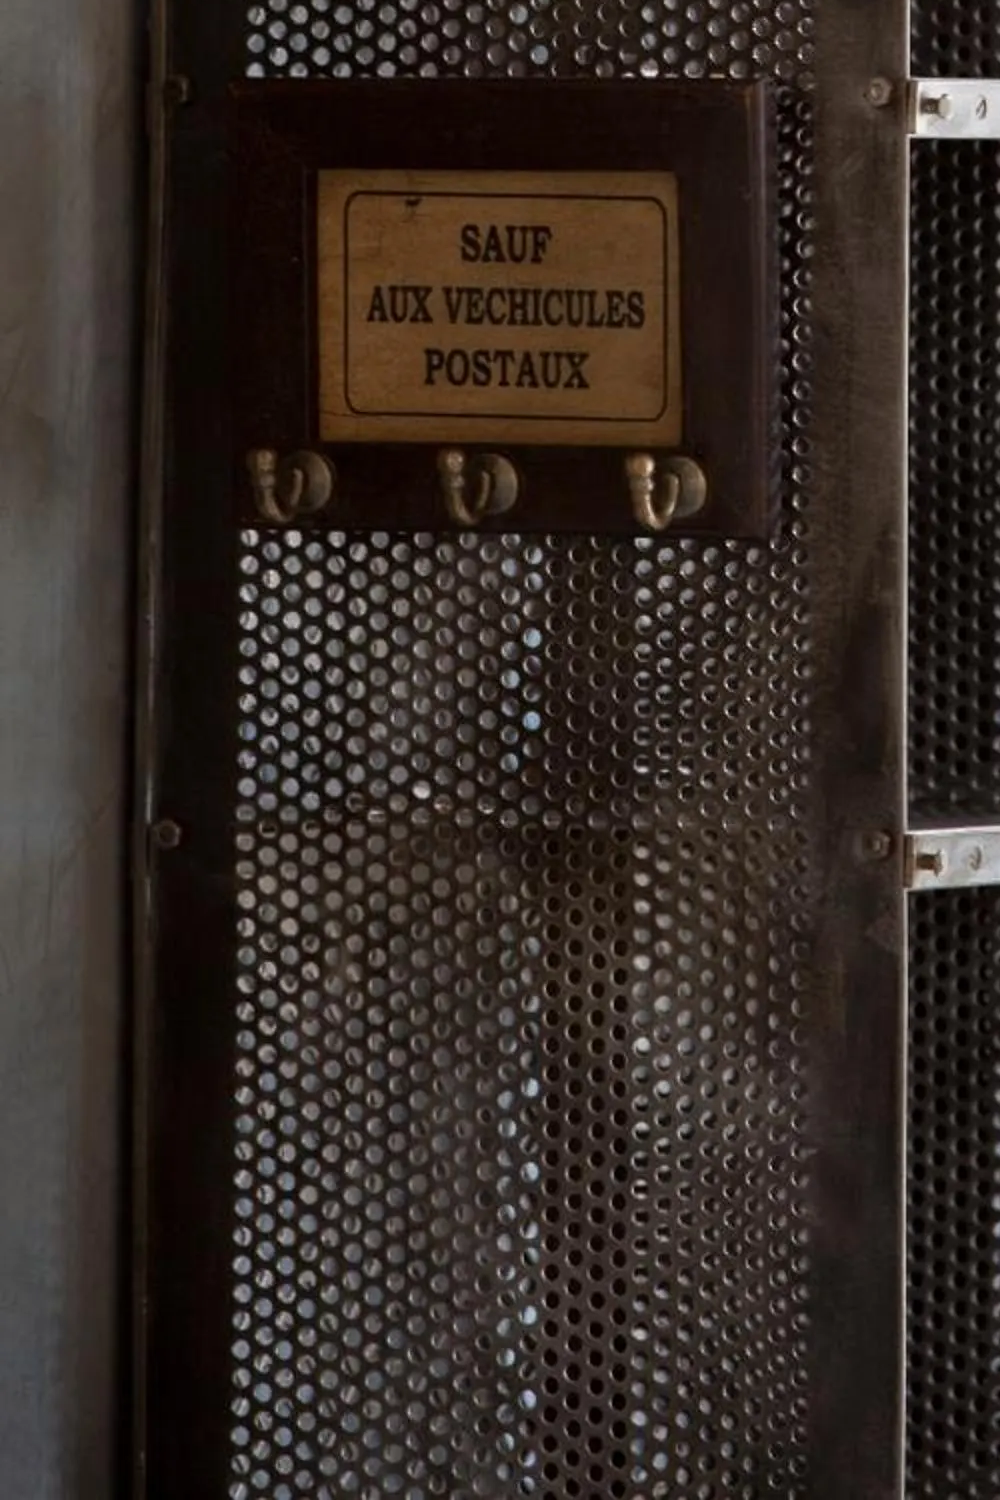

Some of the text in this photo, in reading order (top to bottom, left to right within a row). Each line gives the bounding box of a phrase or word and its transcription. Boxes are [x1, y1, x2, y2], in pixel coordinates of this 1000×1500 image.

[460, 224, 553, 264] SAUF
[366, 286, 646, 329] AUX VECHICULES
[424, 348, 591, 389] POSTAUX
